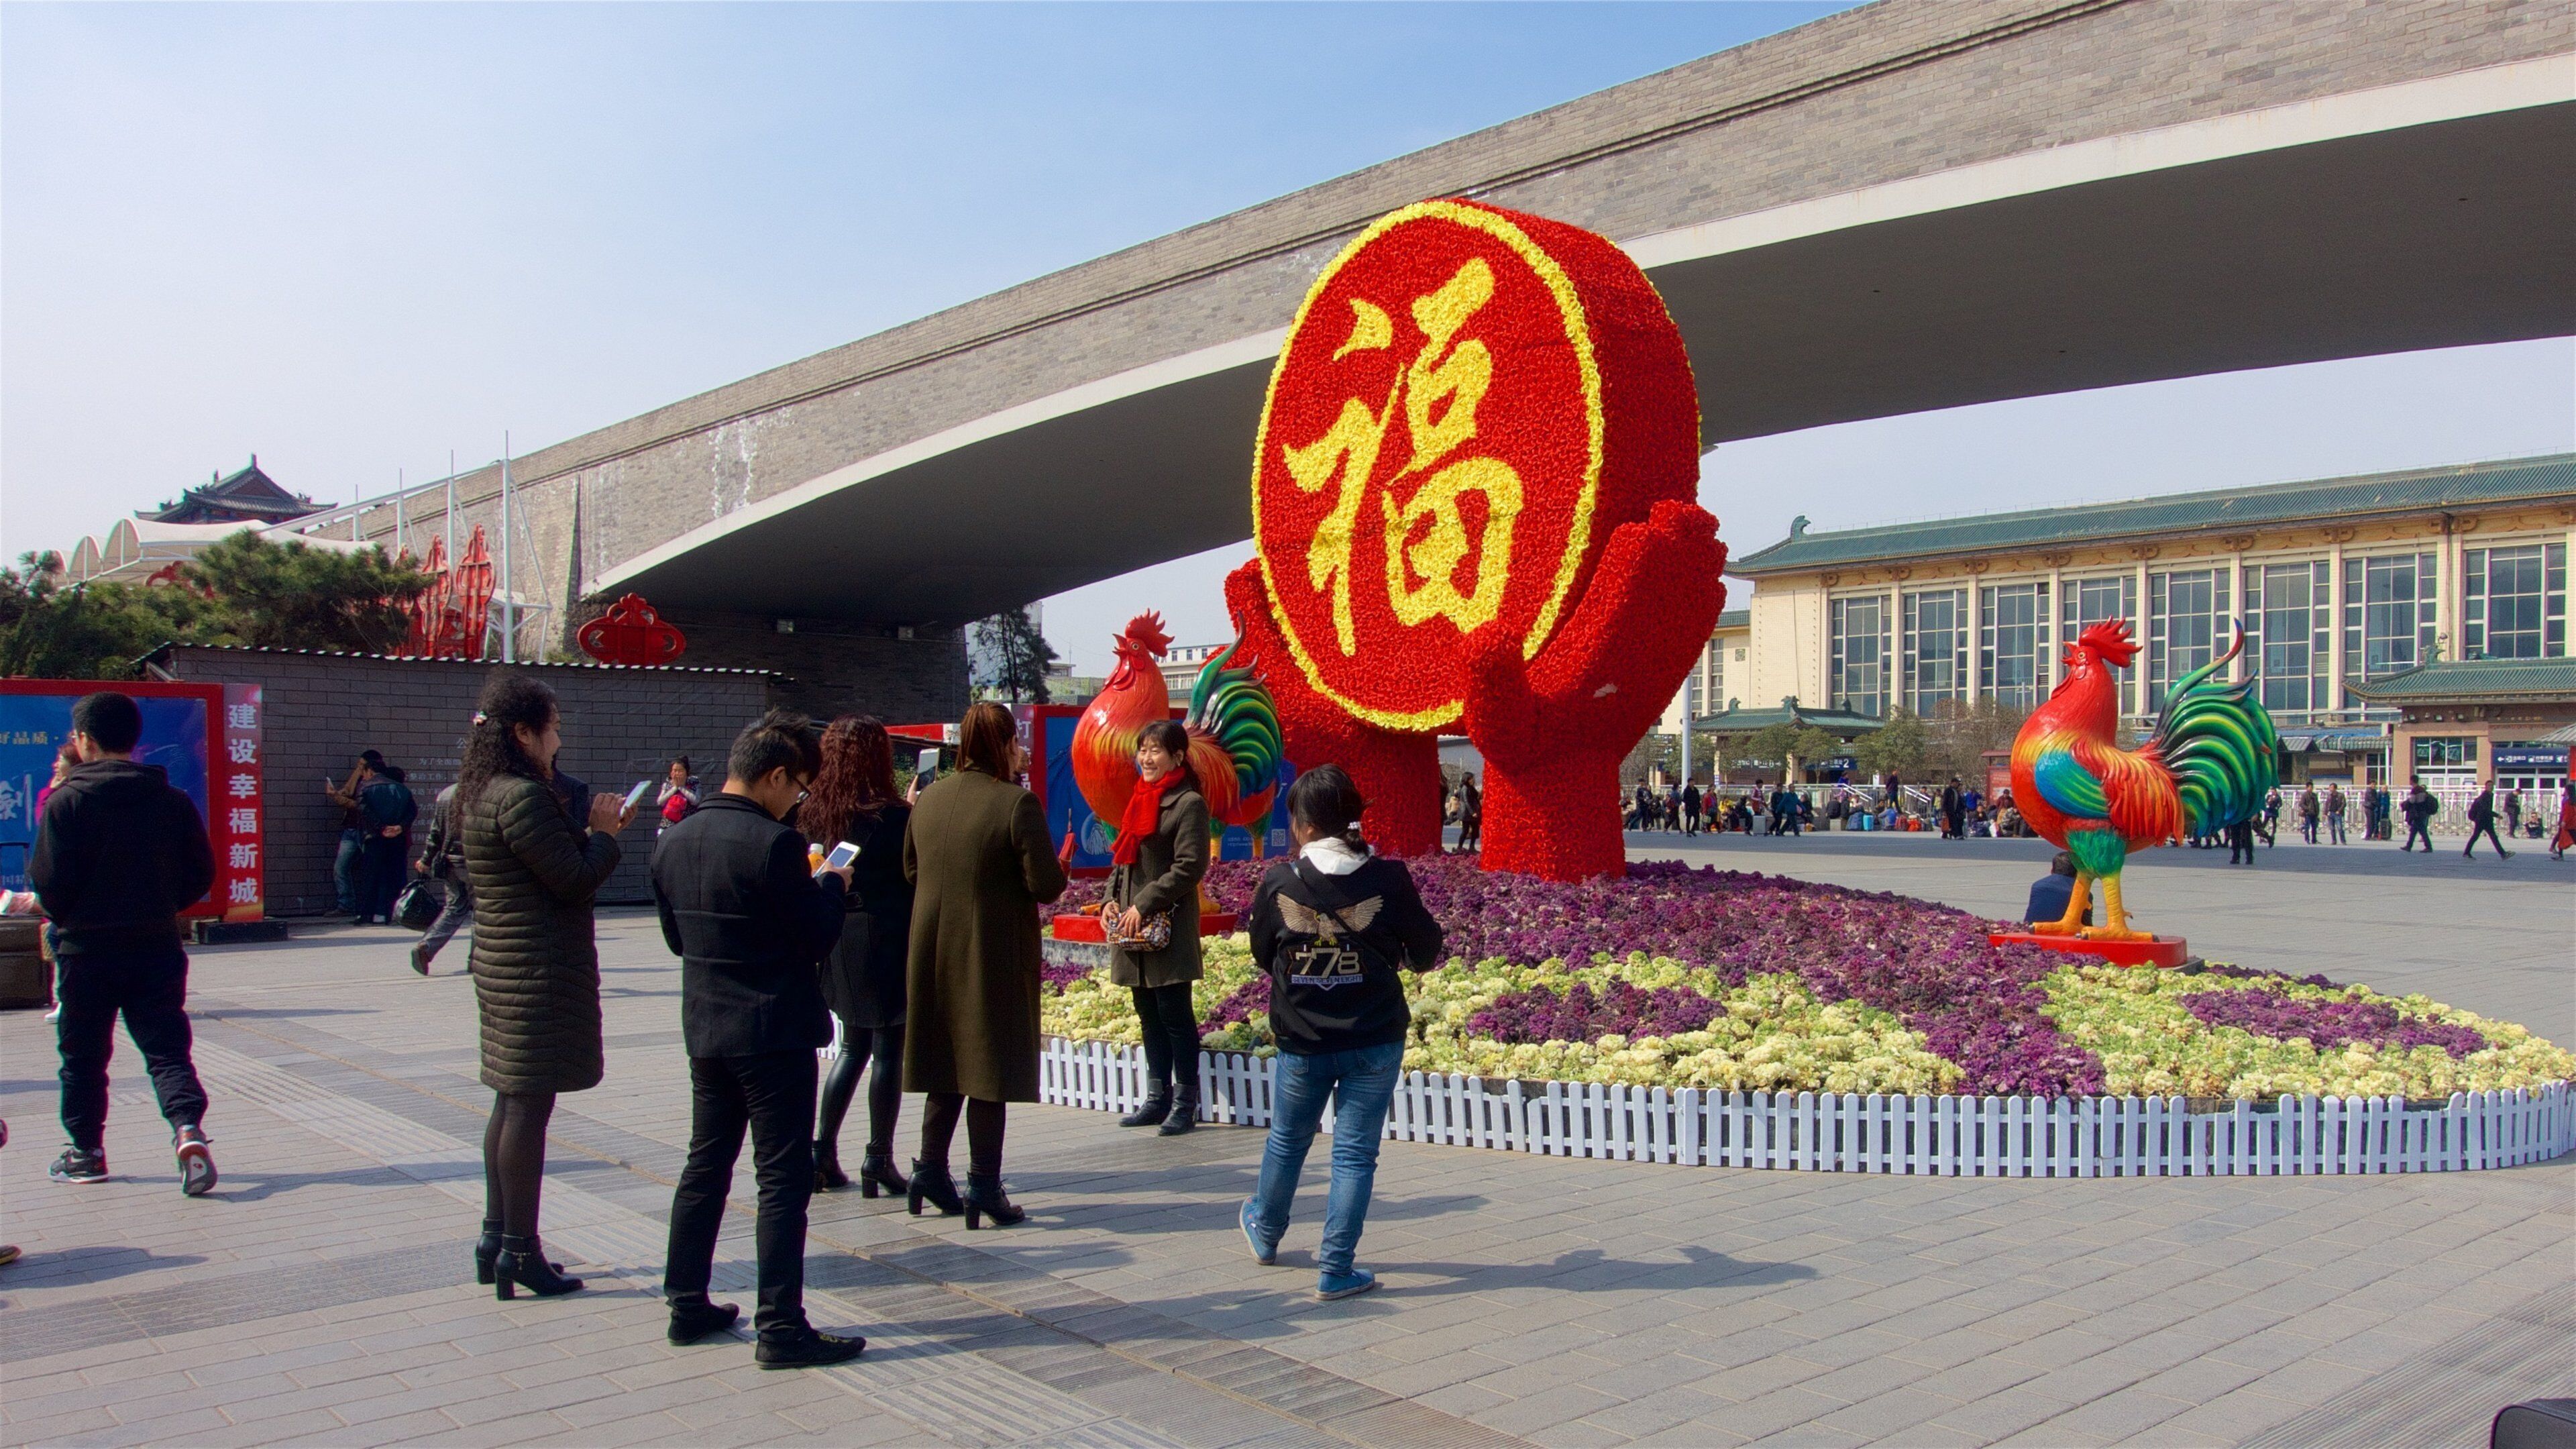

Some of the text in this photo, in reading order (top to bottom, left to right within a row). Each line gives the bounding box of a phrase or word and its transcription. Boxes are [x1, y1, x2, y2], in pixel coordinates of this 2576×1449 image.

[1283, 258, 1523, 657] 福
[229, 703, 258, 904] 建设幸福新城
[1295, 947, 1360, 979] 778
